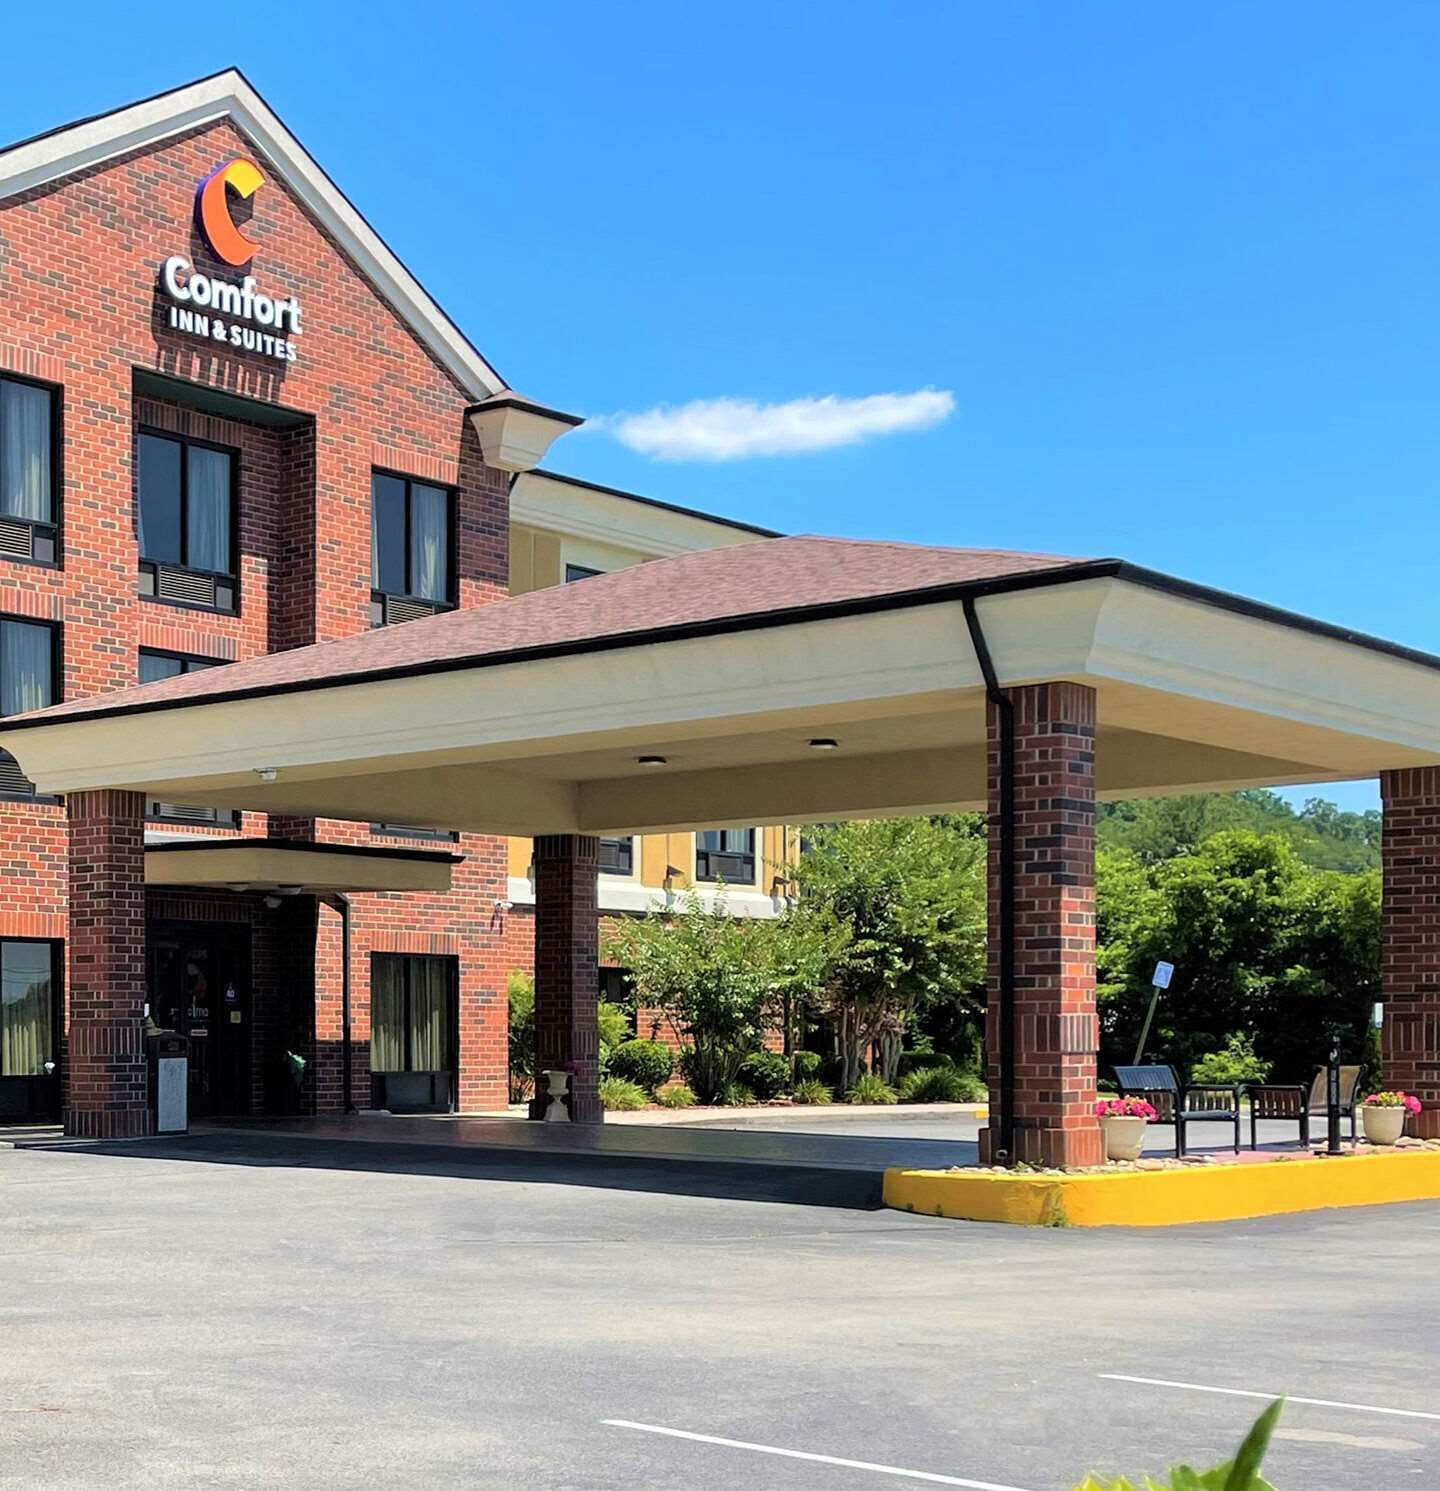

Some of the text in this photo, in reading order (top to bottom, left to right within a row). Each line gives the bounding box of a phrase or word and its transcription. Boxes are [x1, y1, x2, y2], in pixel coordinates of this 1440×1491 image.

[165, 255, 303, 334] Comfort
[170, 307, 297, 361] INN & SUITES
